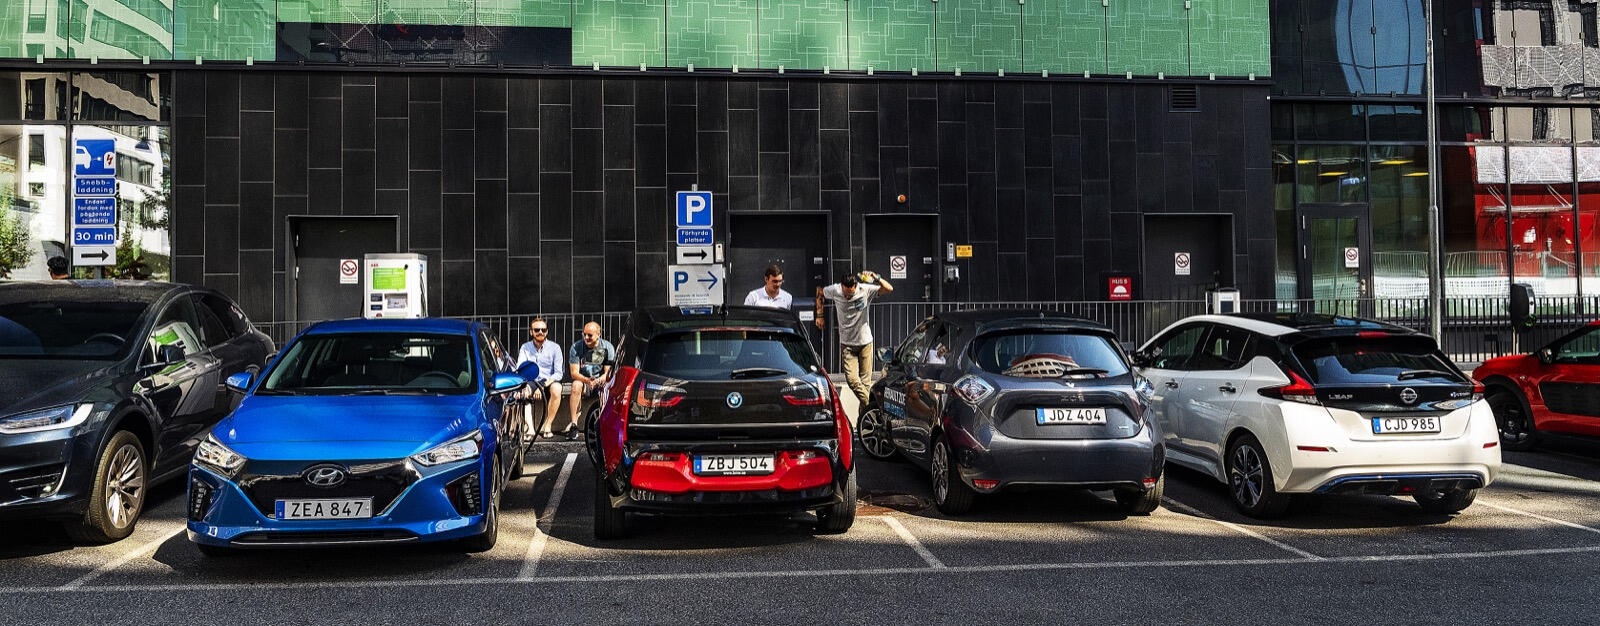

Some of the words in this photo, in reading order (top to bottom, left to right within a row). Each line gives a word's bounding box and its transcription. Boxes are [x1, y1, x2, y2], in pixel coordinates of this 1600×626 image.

[77, 186, 114, 194] laddning
[686, 195, 706, 224] P
[75, 232, 91, 241] 30
[94, 231, 114, 241] min
[674, 271, 689, 292] P
[1050, 409, 1073, 421] JDZ
[1077, 409, 1101, 421] 404
[1384, 418, 1408, 430] CJD
[1411, 417, 1435, 430] 985
[707, 456, 735, 470] ZBJ
[739, 456, 768, 470] 504
[291, 502, 324, 517] ZEA
[330, 501, 364, 517] 847
